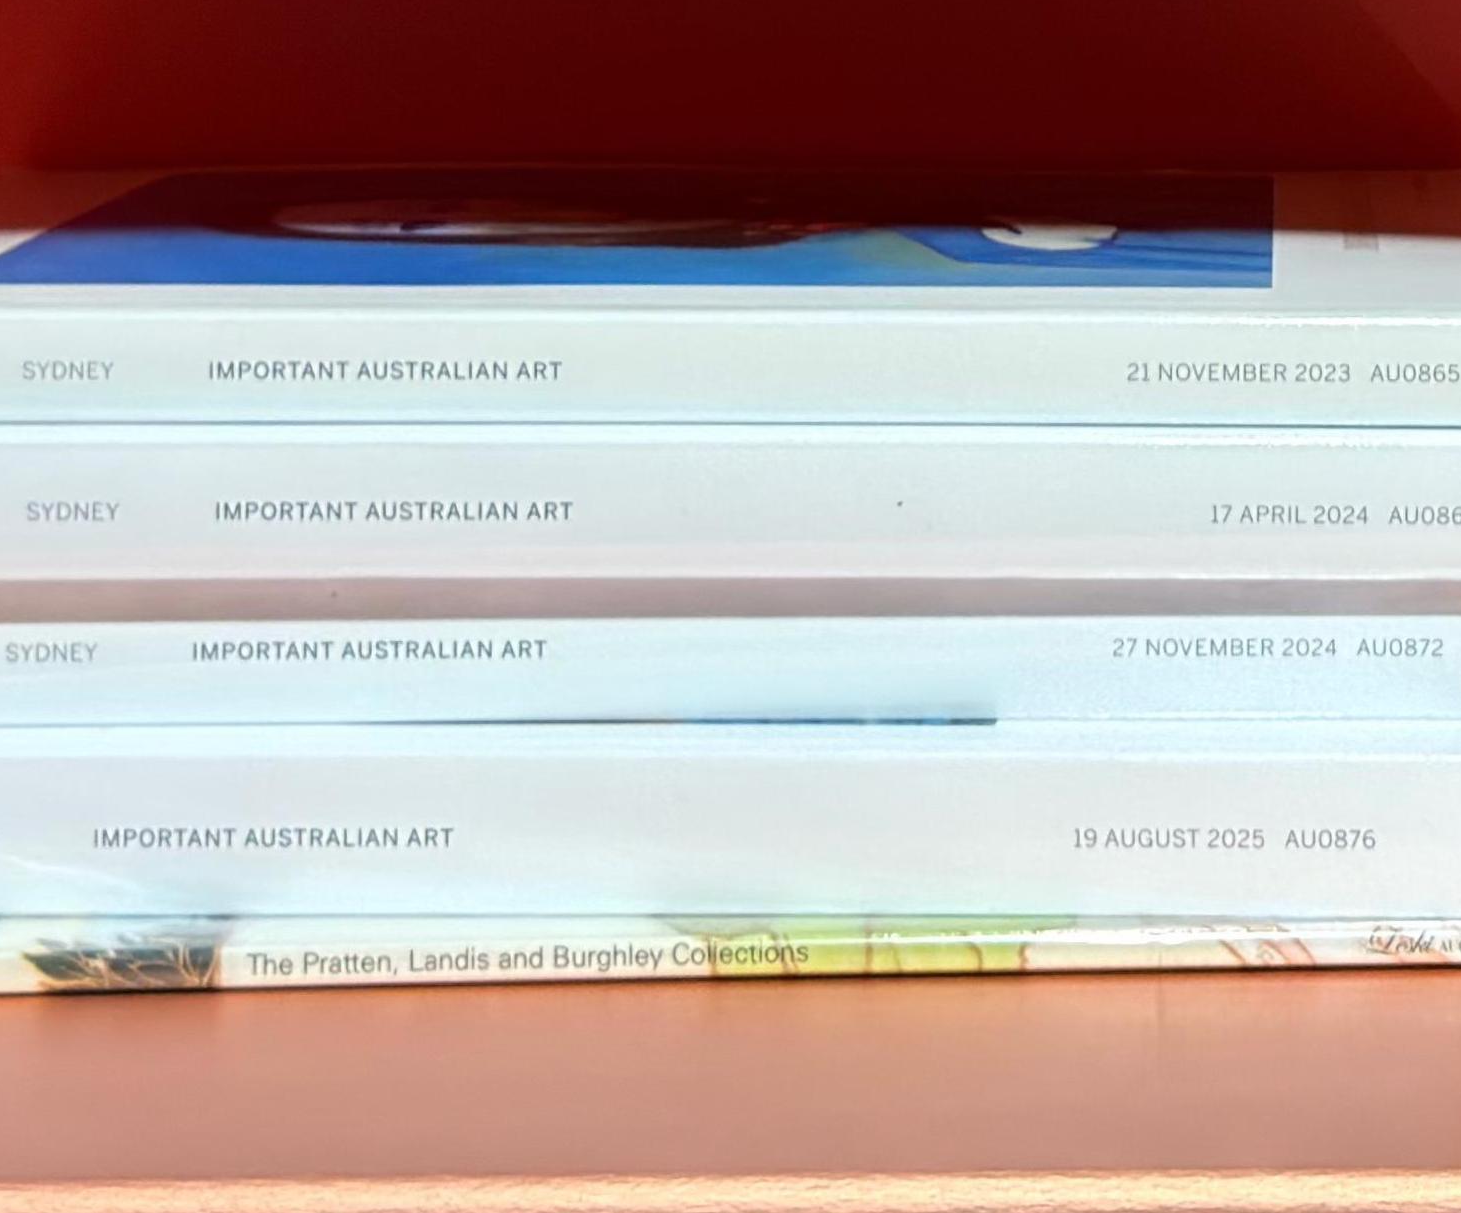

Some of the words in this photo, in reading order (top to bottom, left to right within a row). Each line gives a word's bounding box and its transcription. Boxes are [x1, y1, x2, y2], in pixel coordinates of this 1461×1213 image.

[22, 360, 113, 381] SYDNEY
[209, 360, 348, 381] IMPORTANT
[357, 360, 508, 381] AUSTRALIAN
[516, 361, 562, 381] ART
[1127, 362, 1149, 382] 21
[1158, 362, 1287, 383] NOVEMBER
[1295, 363, 1351, 383] 2023
[1370, 363, 1460, 383] AU0865
[26, 500, 119, 522] SYDNEY
[215, 501, 357, 522] IMPORTANT
[365, 501, 518, 521] AUSTRALIAN
[526, 501, 573, 521] ART
[1211, 504, 1233, 524] 17
[1239, 504, 1306, 525] APRIL
[1313, 505, 1368, 525] 2024
[6, 641, 97, 664] SYDNEY
[192, 640, 334, 661] IMPORTANT
[341, 639, 493, 660] AUSTRALIAN
[501, 639, 547, 659] ART
[1112, 637, 1137, 658] 27
[1145, 637, 1274, 658] NOVEMBER
[1282, 638, 1337, 658] 2024
[1356, 637, 1444, 658] AU0872
[94, 827, 236, 849] IMPORTANT
[244, 827, 398, 849] AUSTRALIAN
[407, 827, 454, 848] ART
[1074, 827, 1098, 849] 19
[1105, 827, 1199, 849] AUGUST
[1207, 828, 1265, 850] 2025
[1285, 828, 1376, 850] AU0876
[247, 952, 293, 976] The
[303, 951, 399, 976] Pratten,
[408, 947, 490, 971] Landis
[498, 946, 544, 970] and
[553, 943, 663, 974] Burghley
[672, 941, 809, 966] Collections
